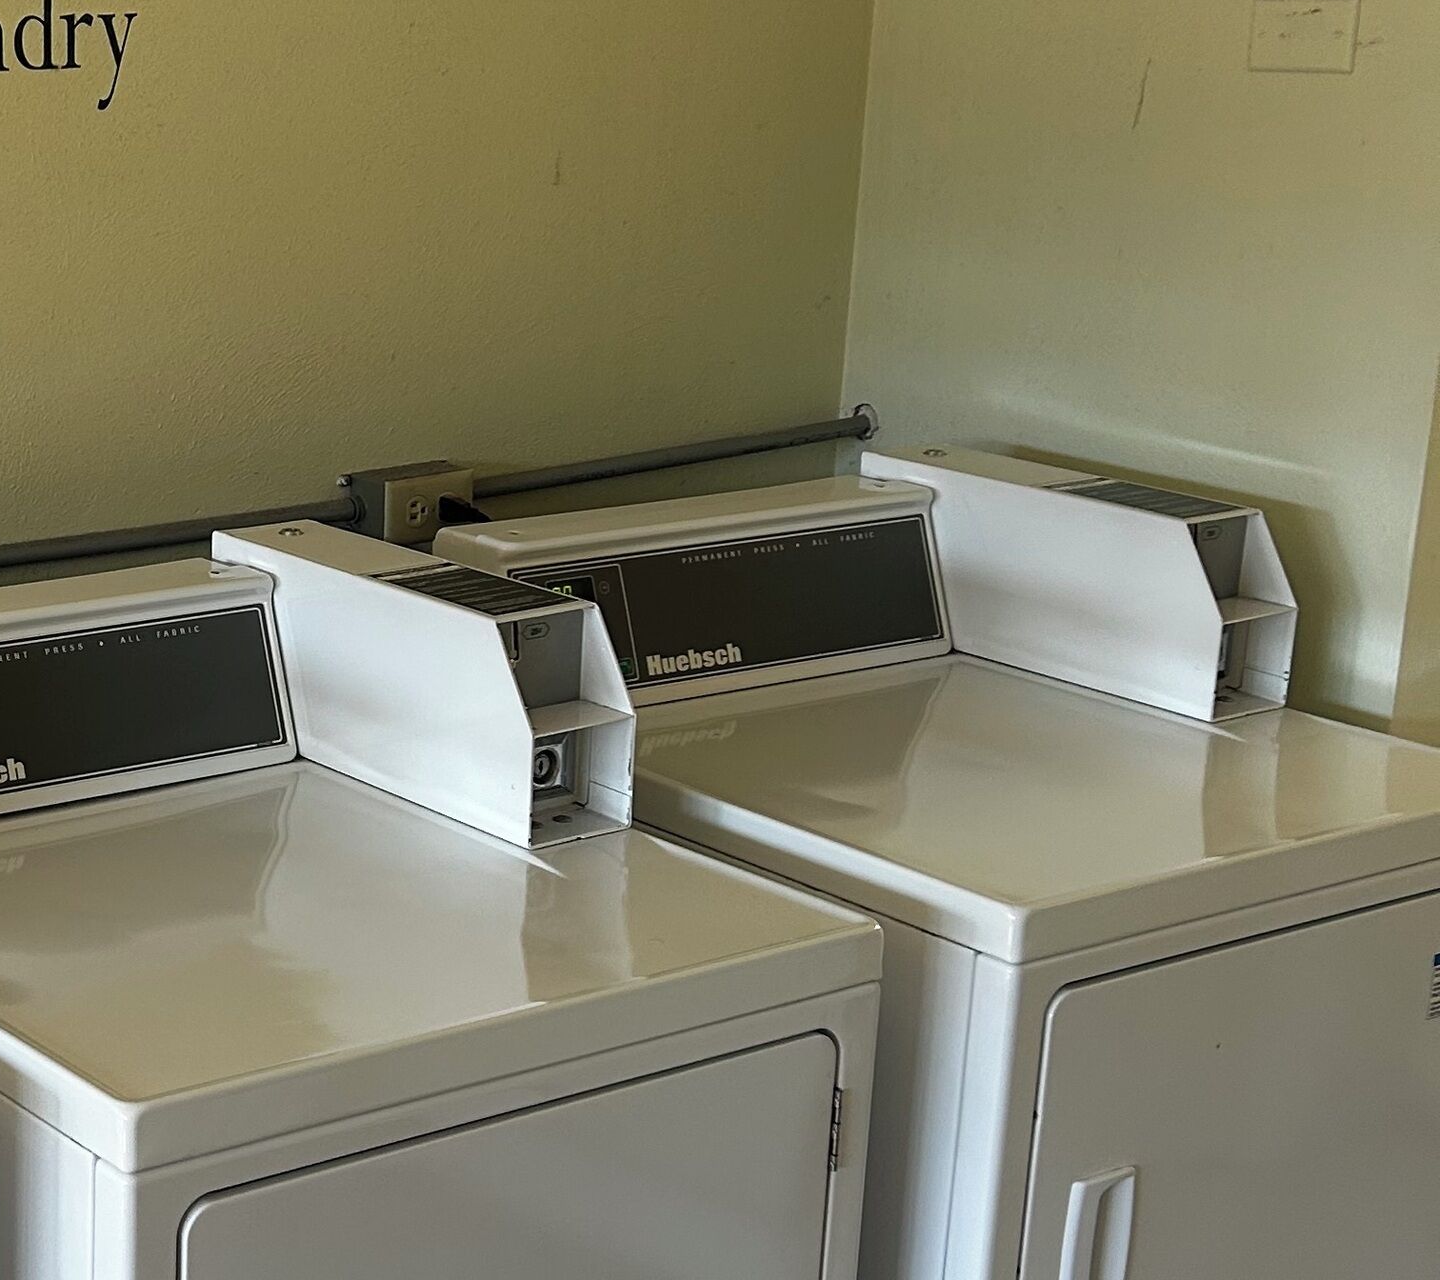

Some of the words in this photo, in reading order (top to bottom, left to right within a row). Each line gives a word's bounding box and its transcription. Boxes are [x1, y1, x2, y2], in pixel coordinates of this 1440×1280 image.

[681, 550, 742, 564] PERMANENT
[753, 544, 785, 554] PRESS
[812, 538, 830, 546] ALL
[839, 531, 875, 543] FABRIC
[45, 642, 85, 656] PRESS
[120, 634, 142, 644] ALL
[156, 625, 201, 639] FABRIC
[646, 643, 742, 676] Huebsch
